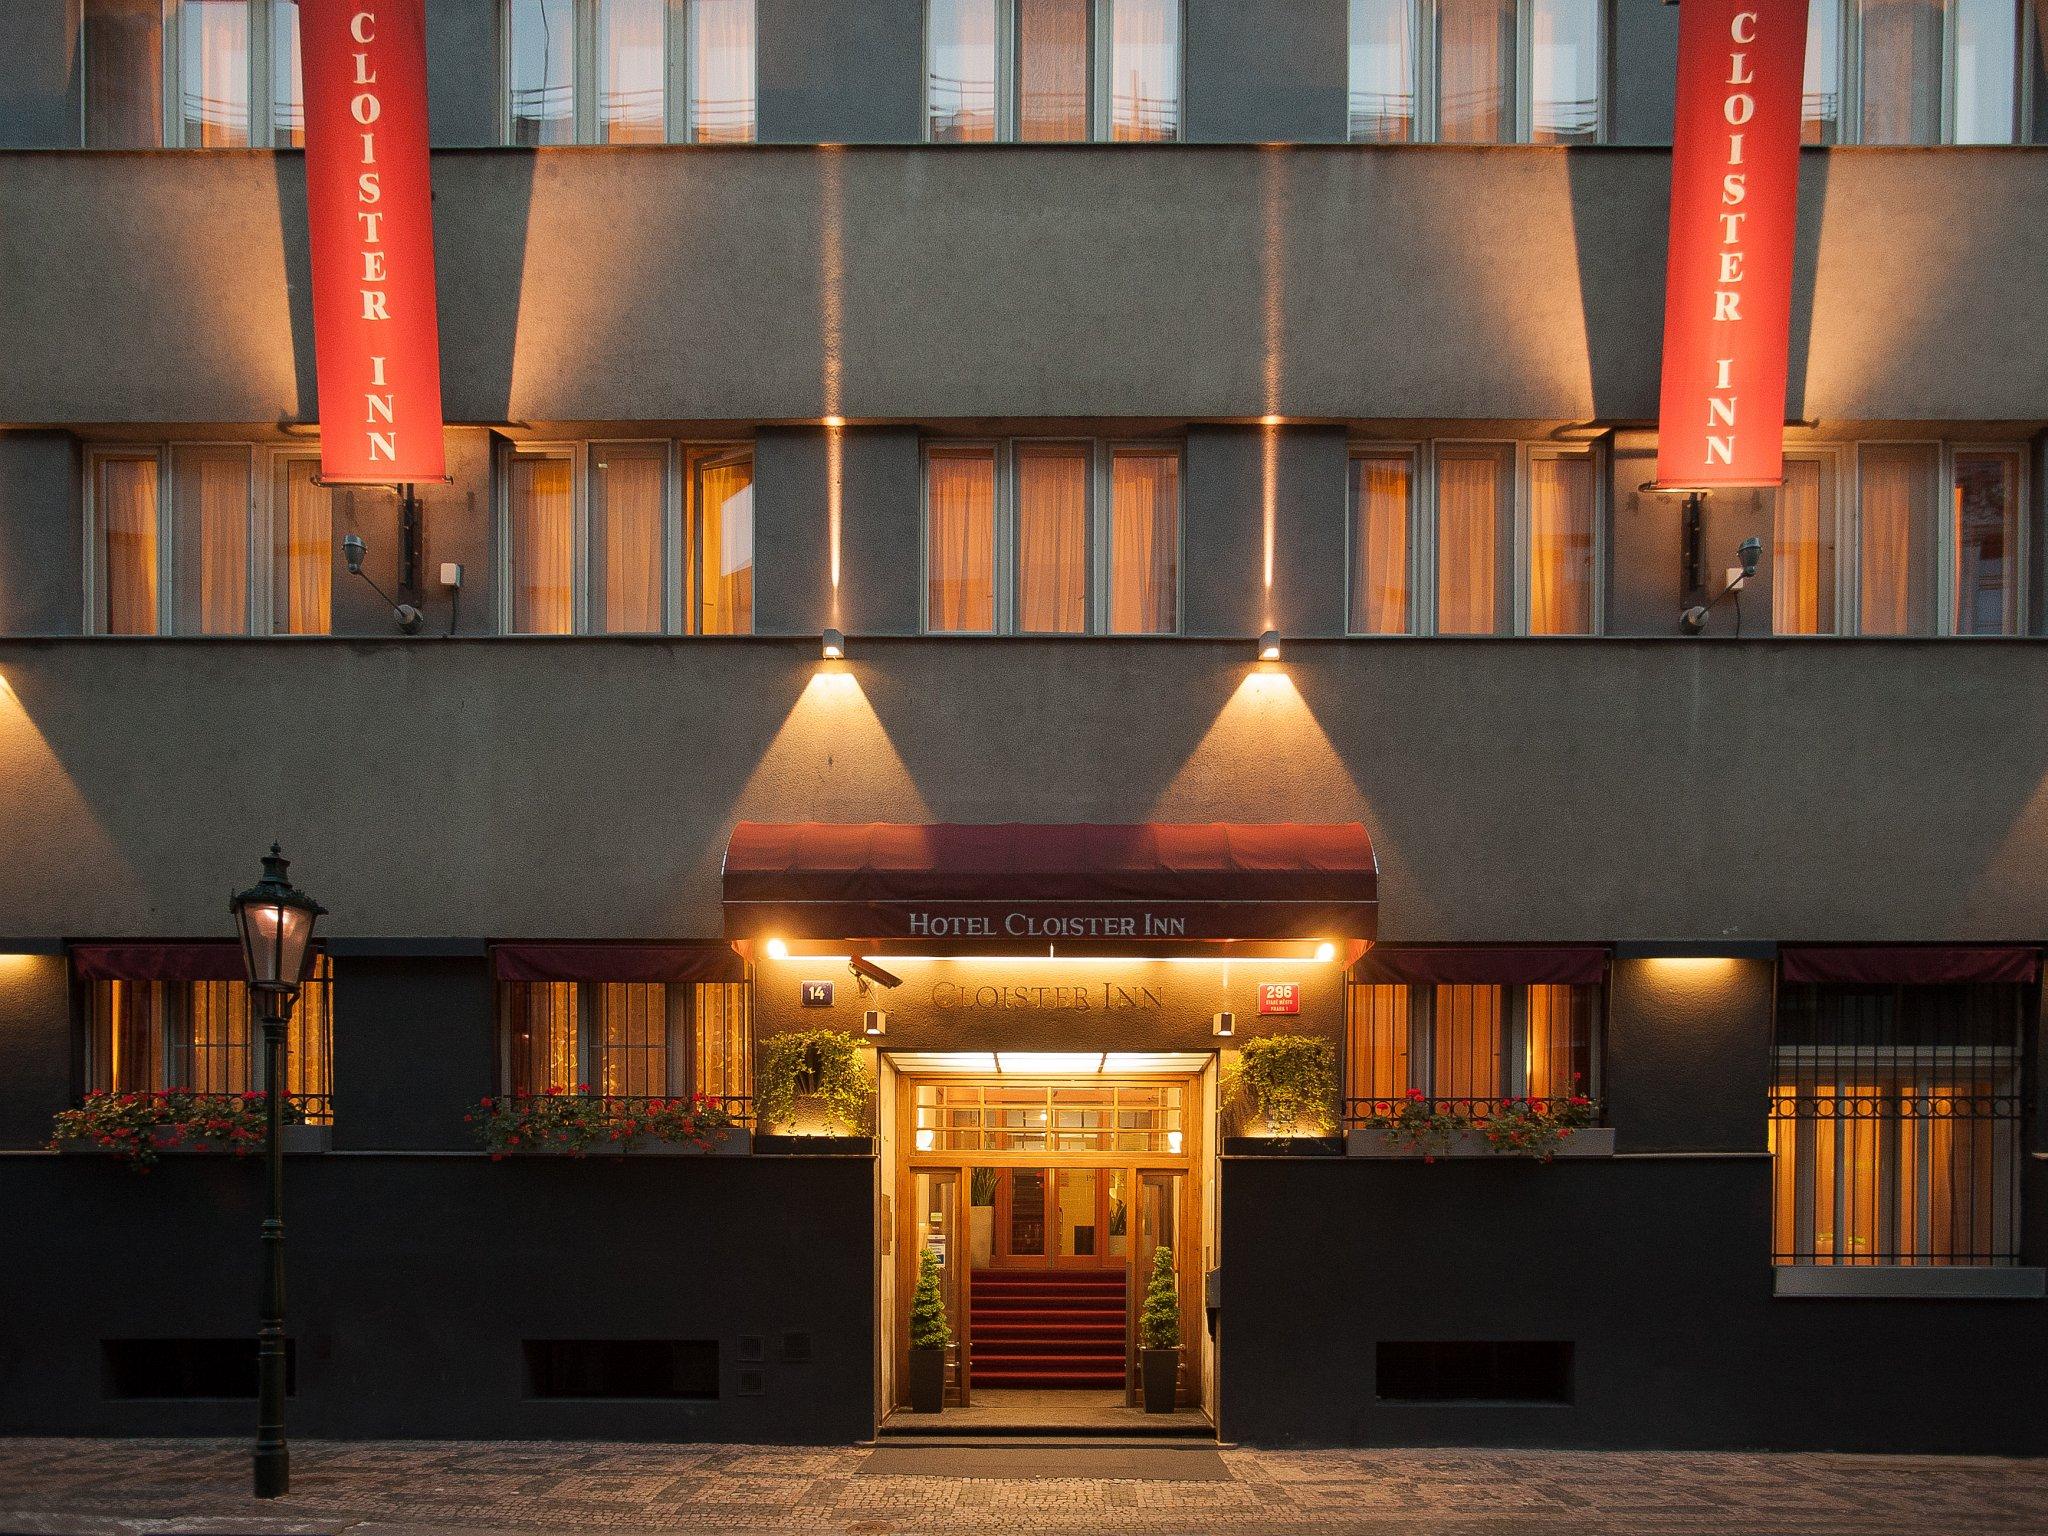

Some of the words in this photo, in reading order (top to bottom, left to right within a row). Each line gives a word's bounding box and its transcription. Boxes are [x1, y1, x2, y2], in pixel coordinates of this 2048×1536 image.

[350, 12, 390, 321] CLOISTER
[1713, 12, 1757, 322] CLOISTER
[364, 355, 398, 463] INN
[1704, 358, 1737, 466] INN
[909, 912, 997, 936] HOTEL
[1005, 912, 1136, 936] CLOISTER
[1144, 913, 1185, 936] INN
[808, 986, 825, 1000] 14
[931, 981, 1091, 1010] CLOISTER
[1103, 982, 1163, 1009] INN
[1266, 985, 1293, 999] 296
